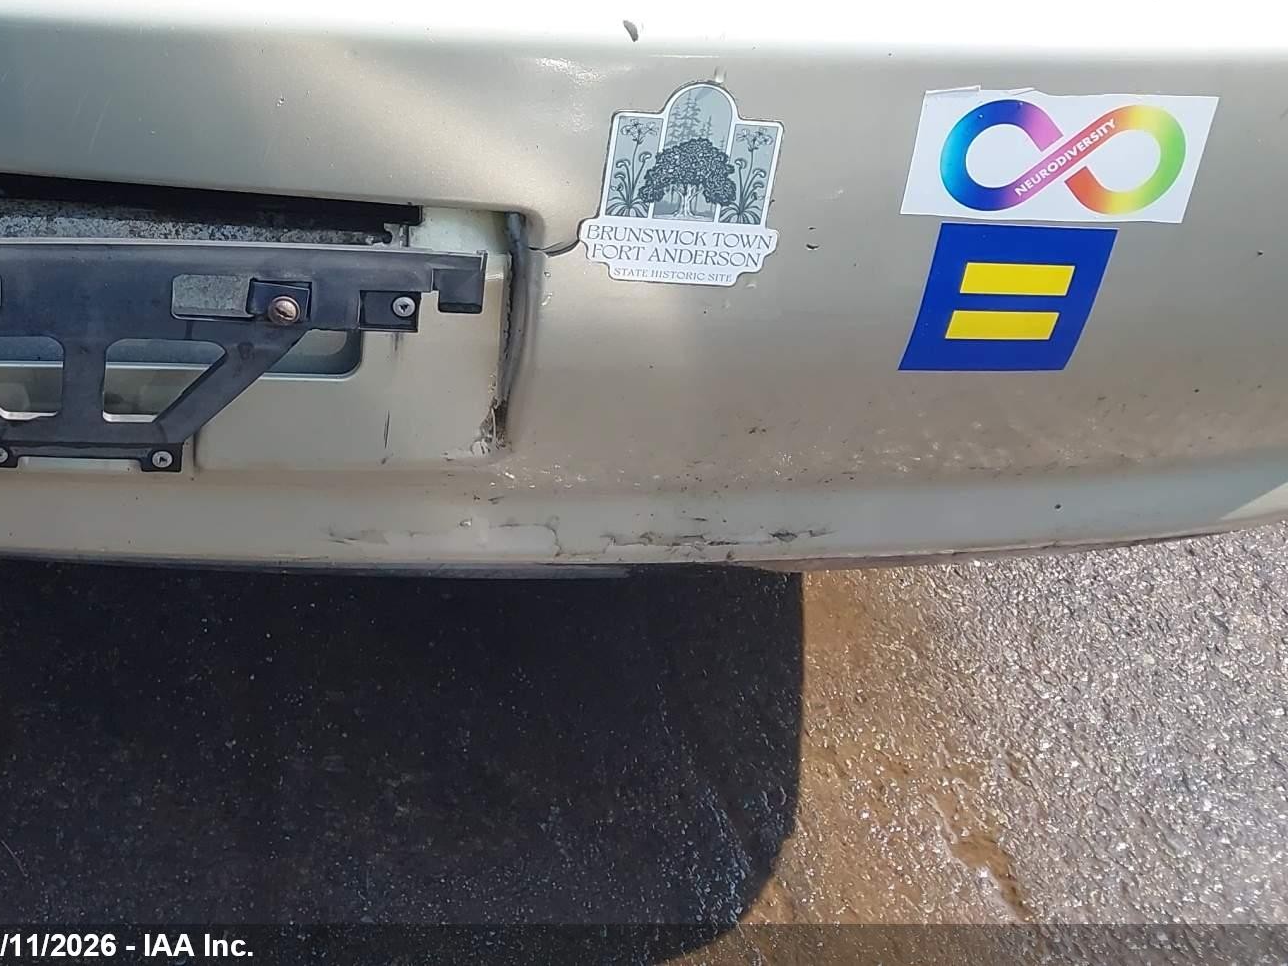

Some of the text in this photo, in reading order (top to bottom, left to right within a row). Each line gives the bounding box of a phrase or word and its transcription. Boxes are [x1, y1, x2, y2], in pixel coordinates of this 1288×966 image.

[1014, 118, 1116, 197] NEURODIVERSITY
[587, 224, 772, 250] BRUNSWICK TOWN
[592, 243, 761, 268] FORT ANDERSON
[614, 267, 733, 283] STATE HISTORIC SITE
